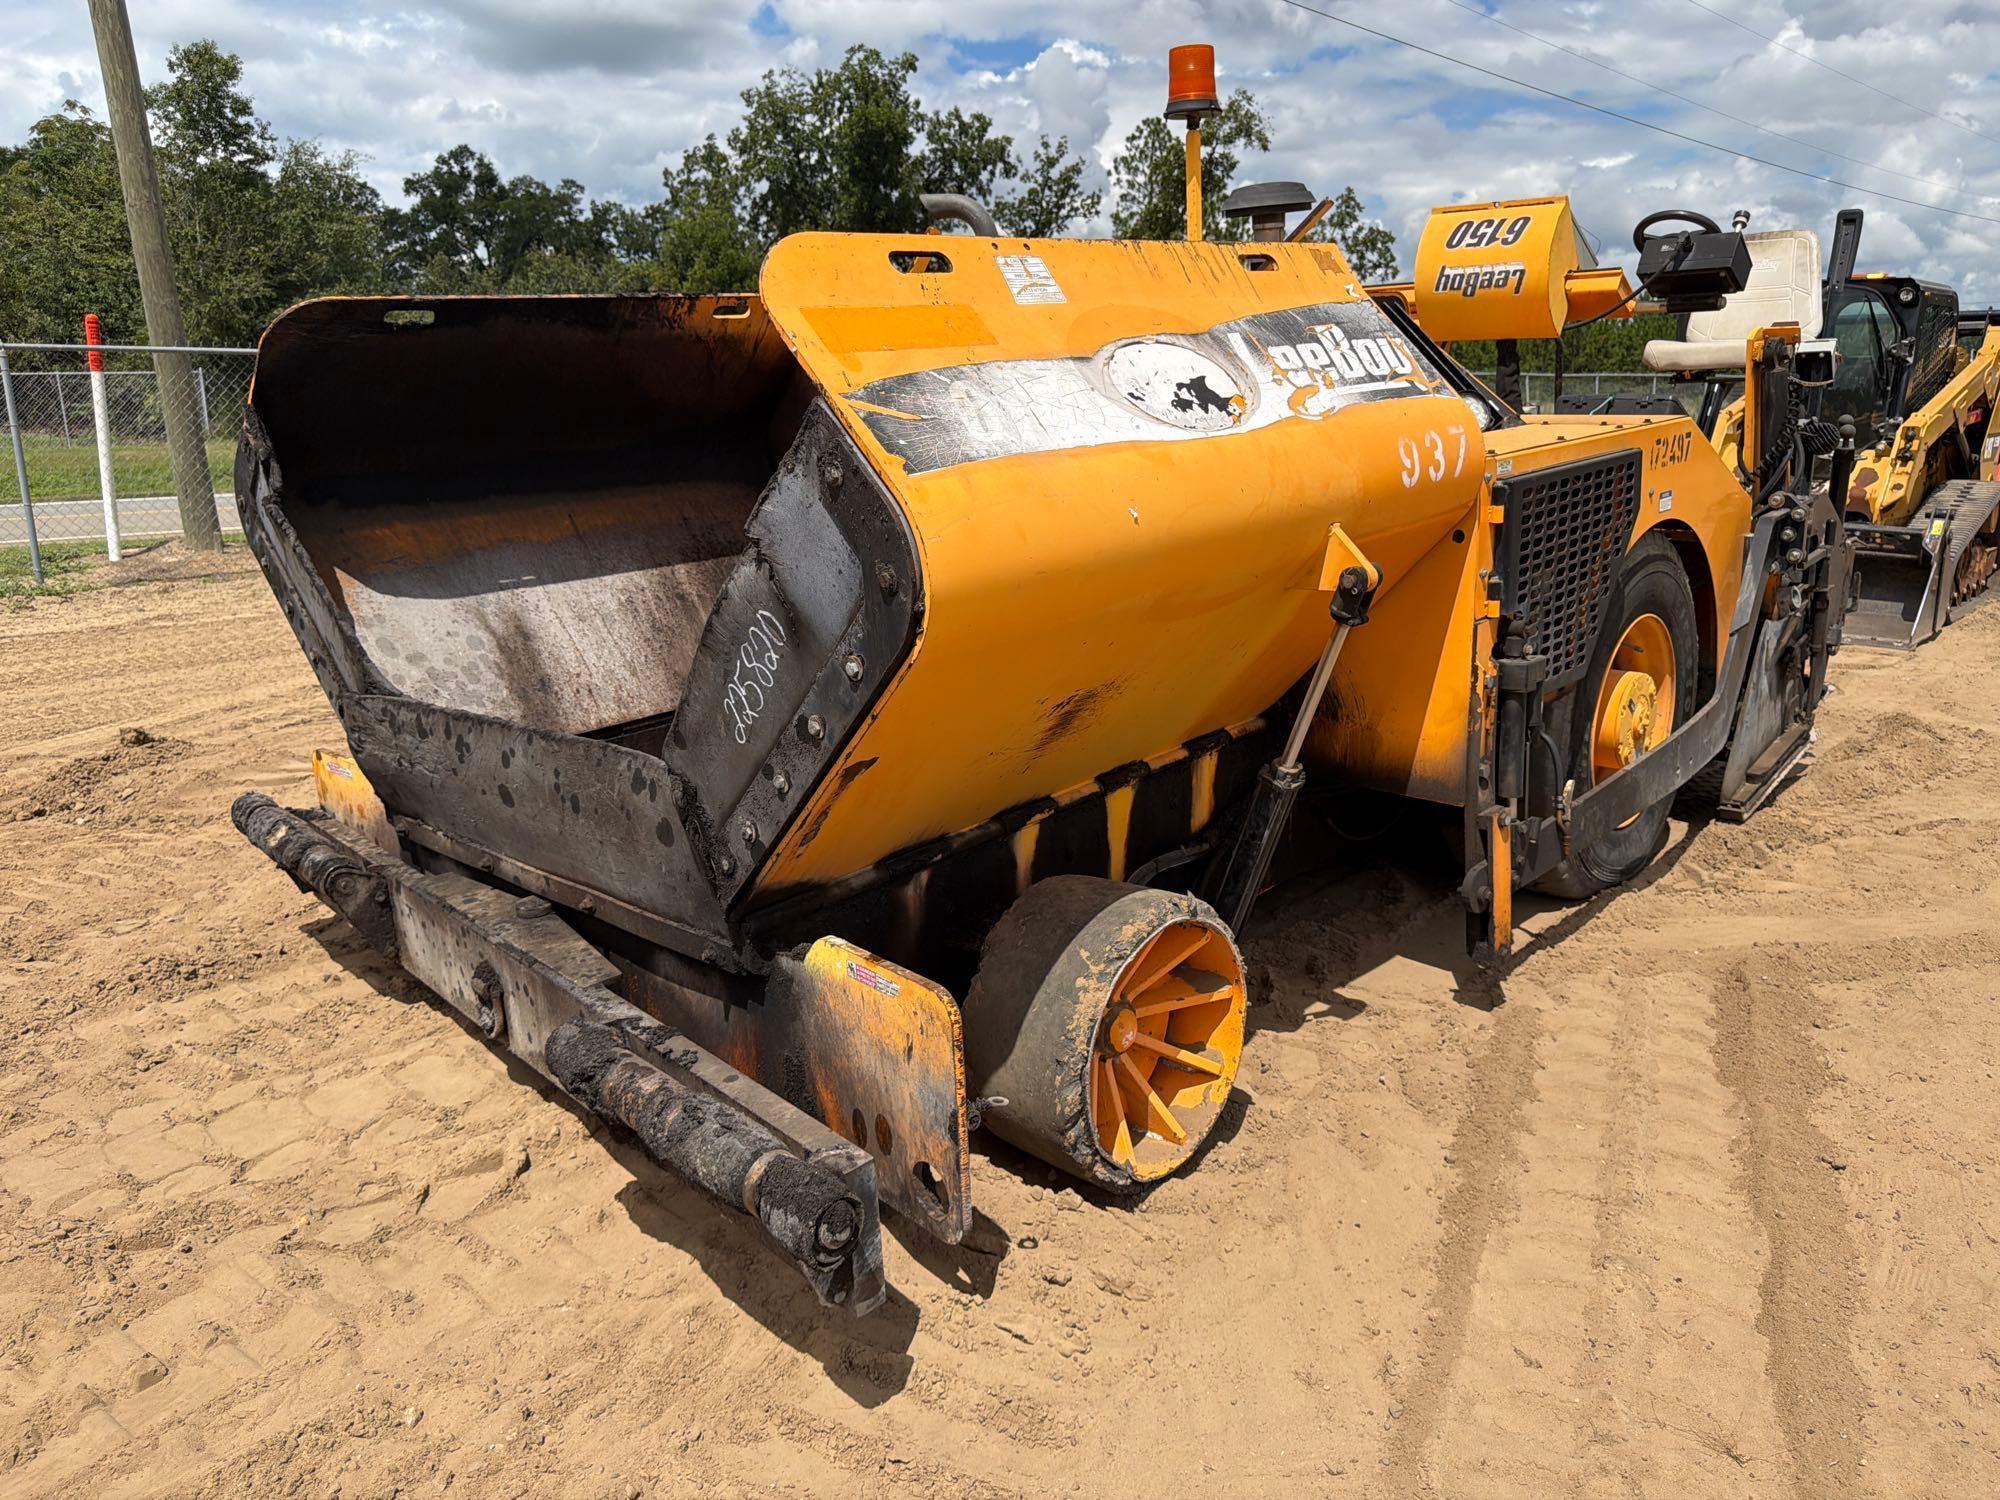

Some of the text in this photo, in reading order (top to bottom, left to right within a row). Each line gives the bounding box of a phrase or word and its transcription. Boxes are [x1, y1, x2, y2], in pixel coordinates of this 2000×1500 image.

[1445, 215, 1531, 250] 6150
[1434, 264, 1526, 298] LeeBoy
[1398, 424, 1467, 489] 937
[724, 610, 786, 744] 225820
